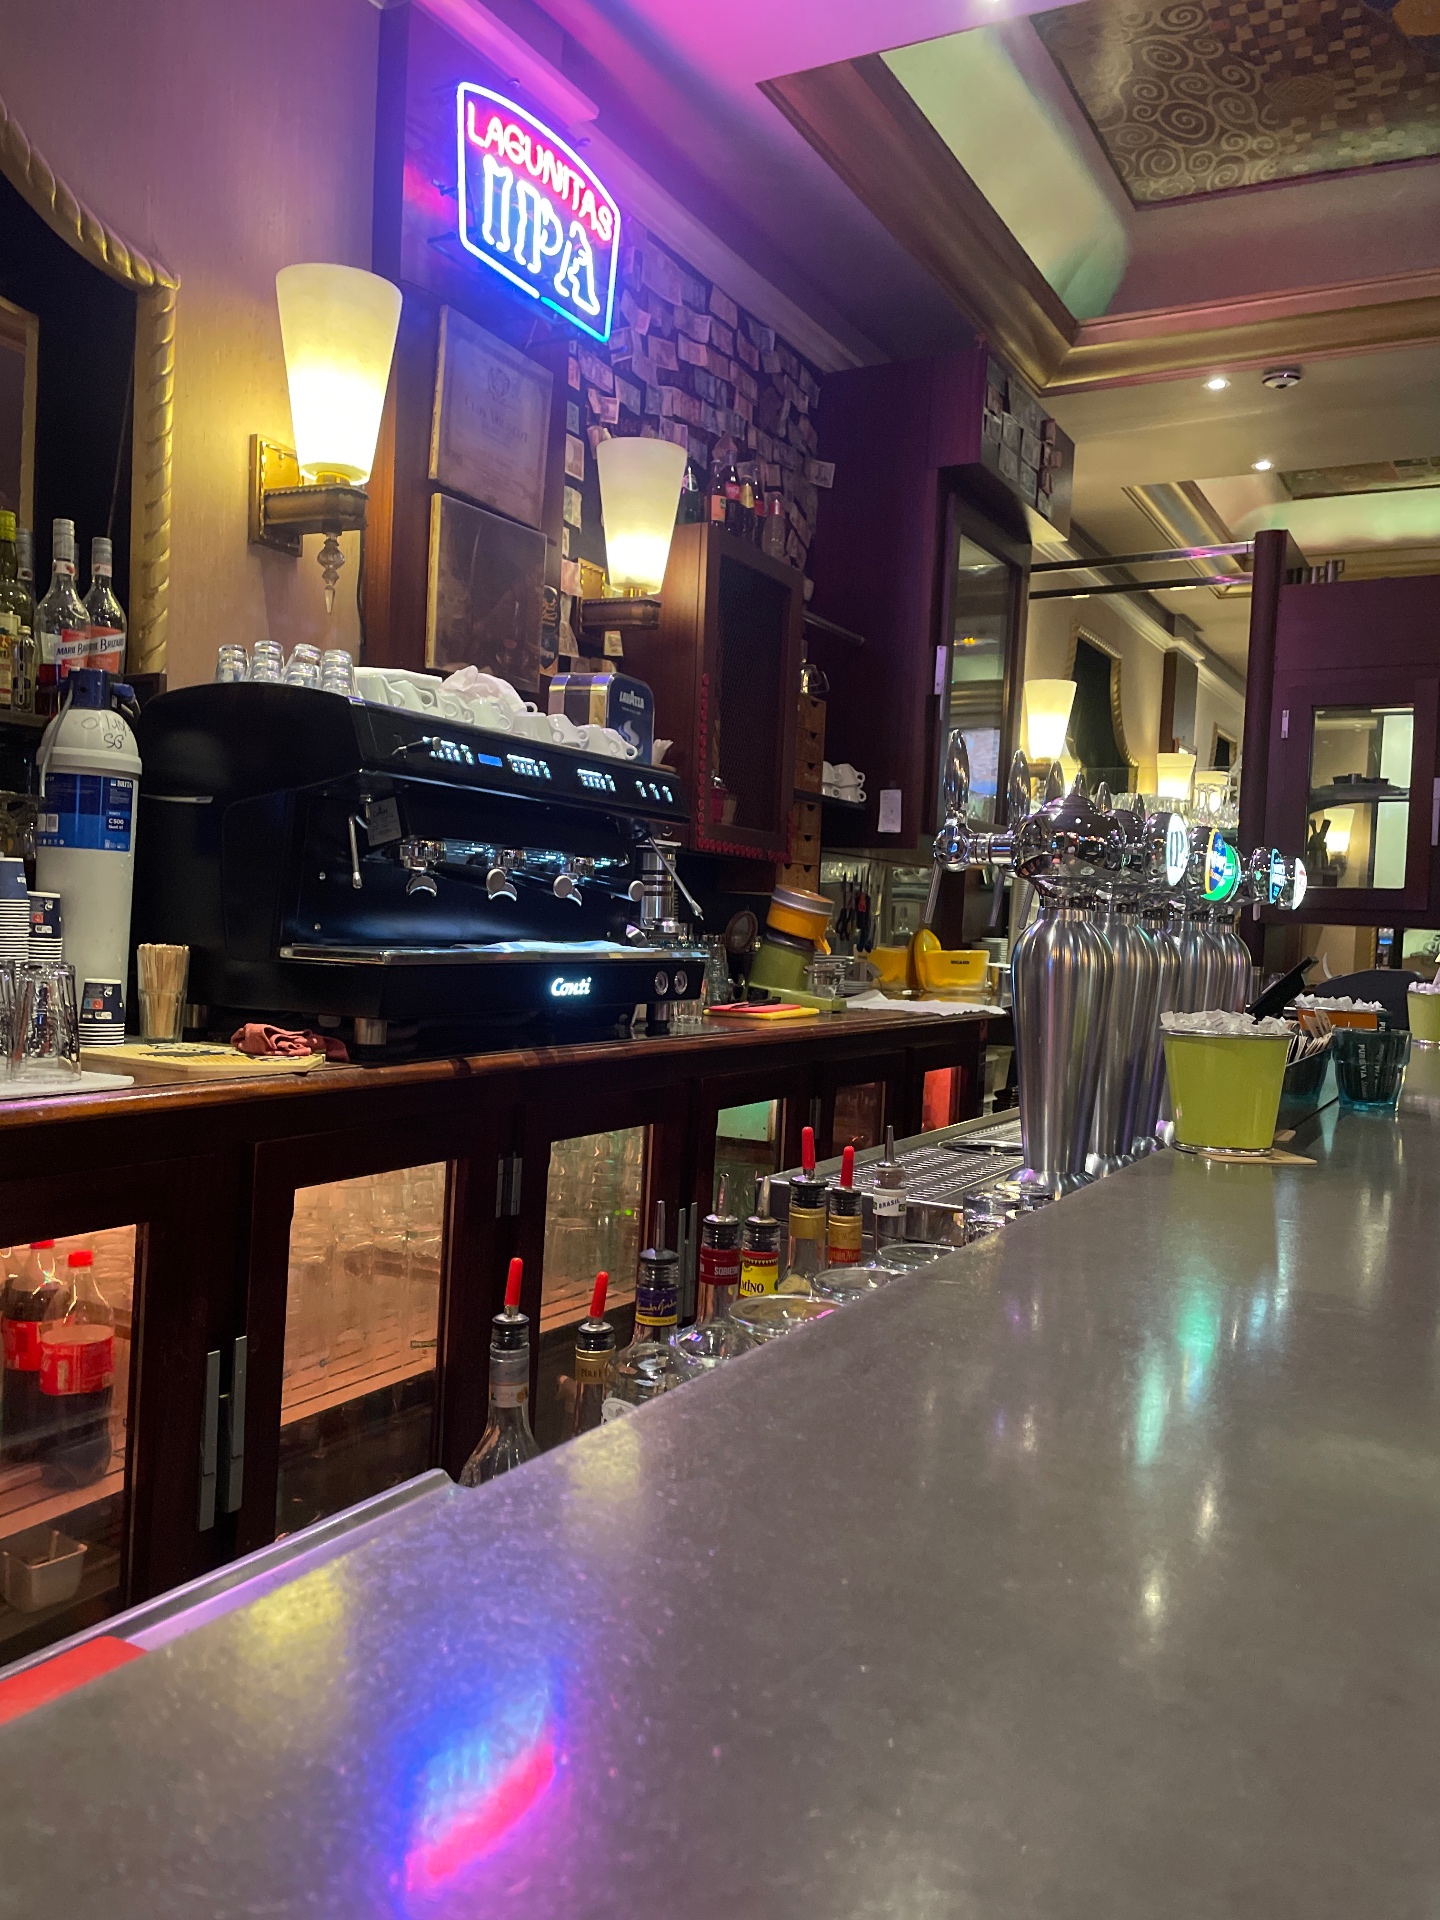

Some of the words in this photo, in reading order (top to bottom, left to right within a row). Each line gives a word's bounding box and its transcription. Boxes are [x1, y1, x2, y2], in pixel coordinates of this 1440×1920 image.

[467, 101, 613, 241] LAGUNITAS
[482, 154, 600, 316] IPA
[551, 976, 592, 996] Conti
[878, 1198, 901, 1209] BRASIL
[714, 1264, 739, 1276] SOBIES
